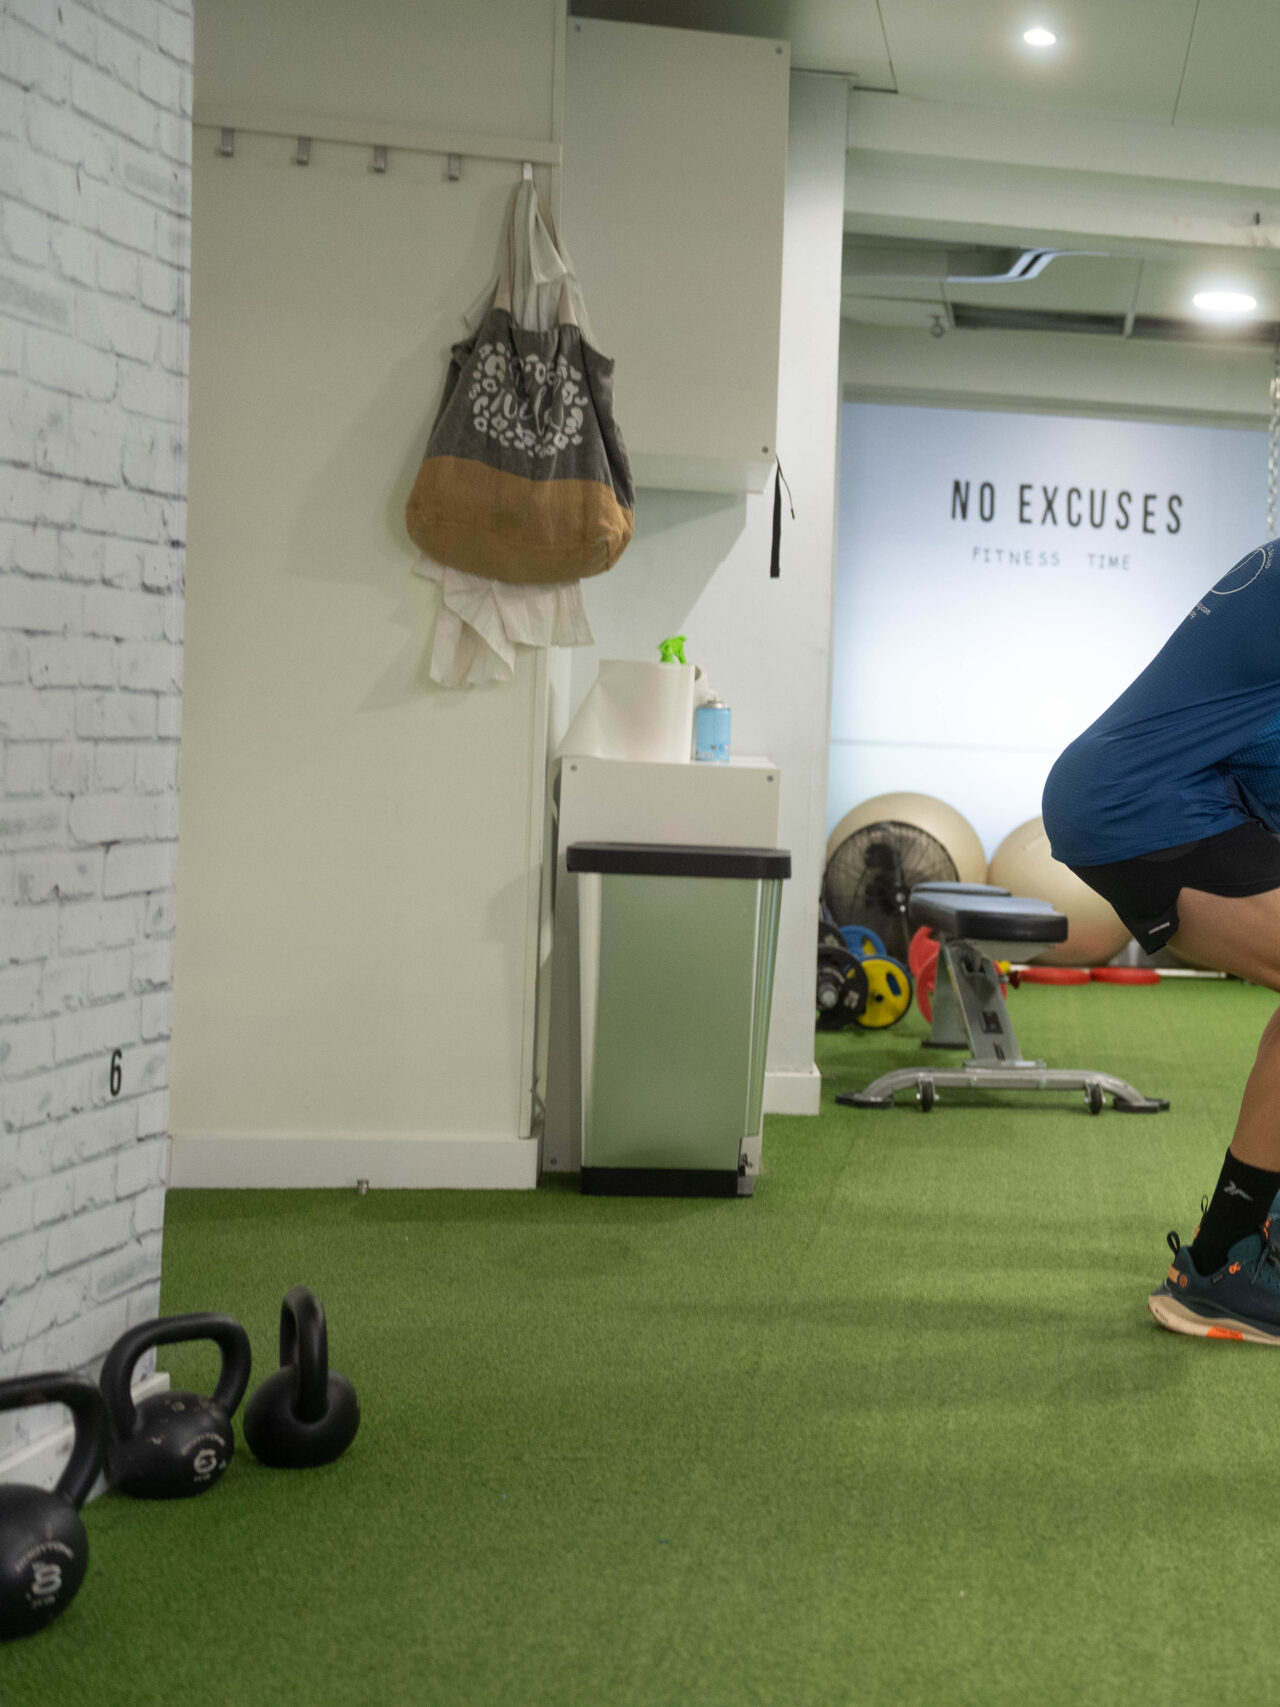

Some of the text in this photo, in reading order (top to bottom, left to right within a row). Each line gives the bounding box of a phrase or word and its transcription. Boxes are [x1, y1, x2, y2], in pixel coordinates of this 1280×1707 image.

[952, 480, 1183, 534] NO EXCUSES
[972, 547, 1131, 570] FITNESS TIME
[110, 1049, 122, 1097] 6
